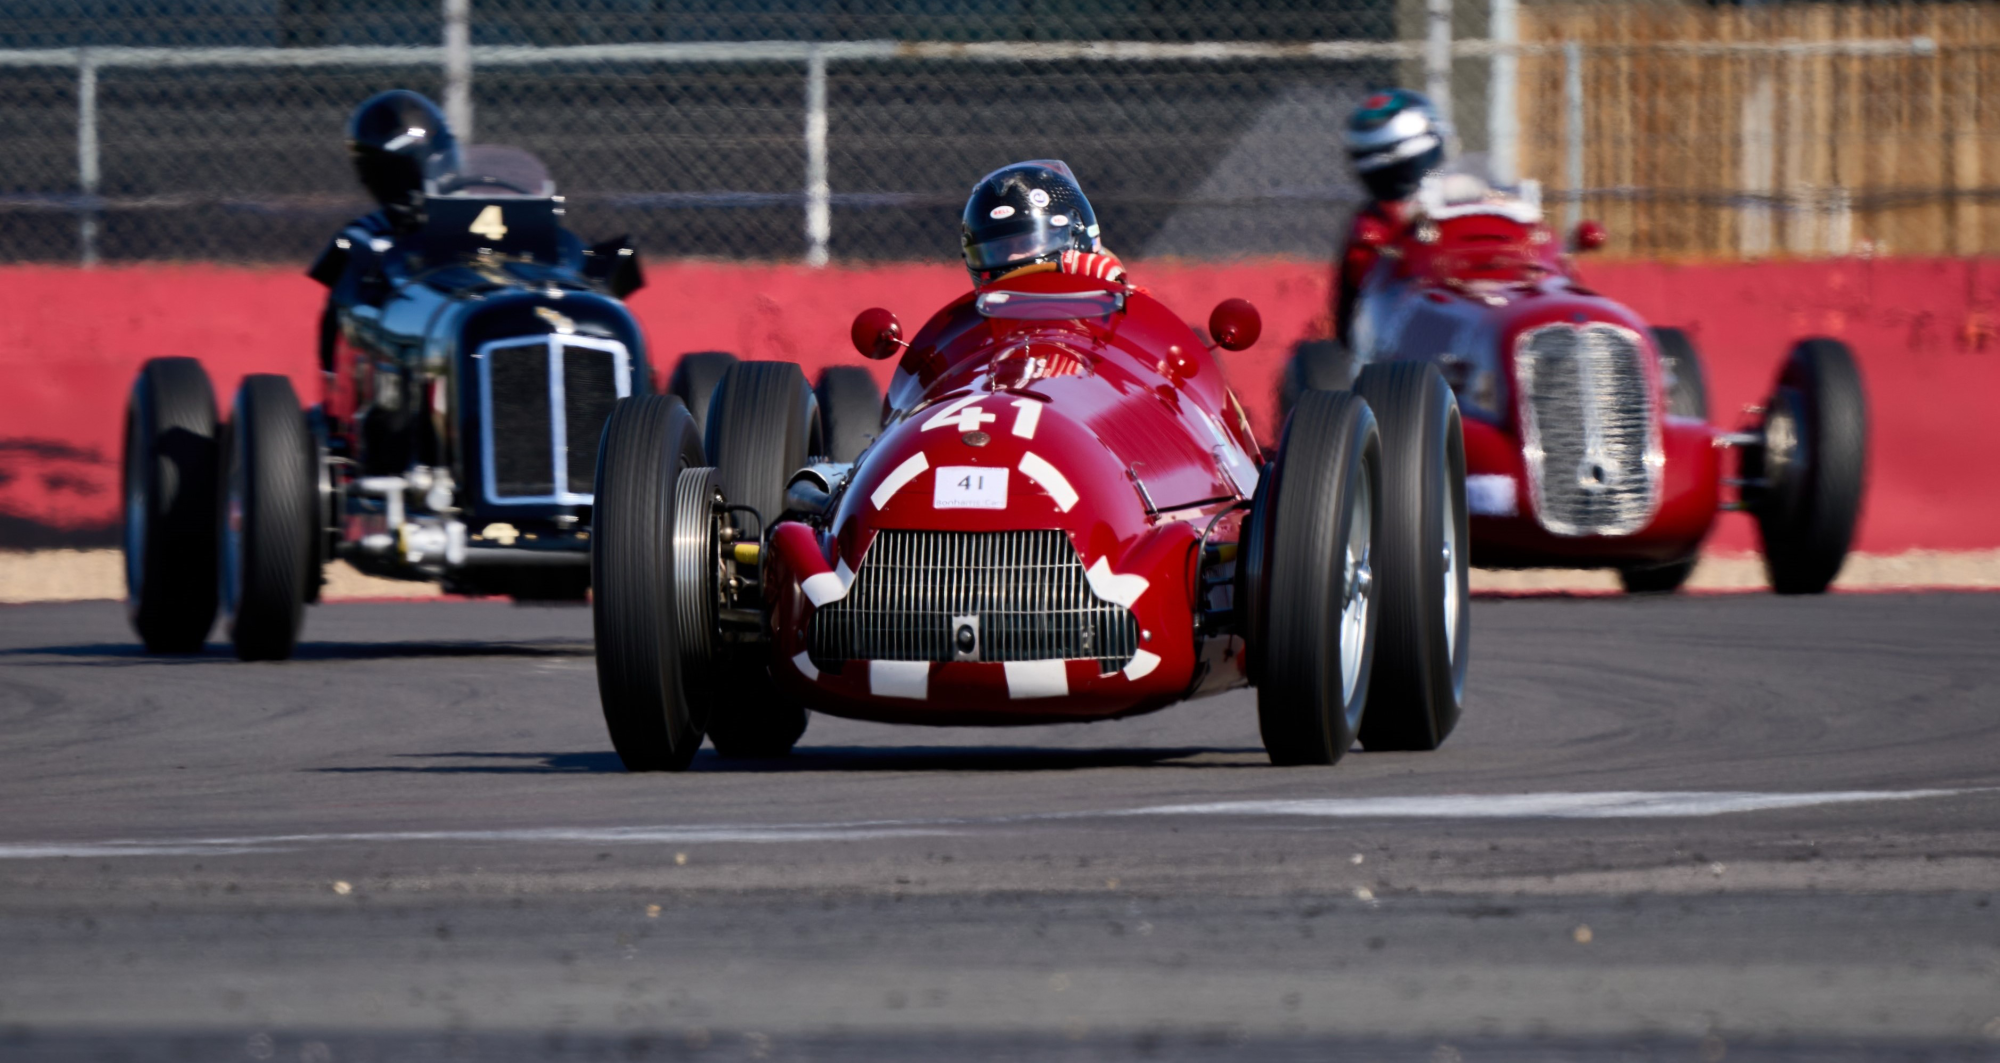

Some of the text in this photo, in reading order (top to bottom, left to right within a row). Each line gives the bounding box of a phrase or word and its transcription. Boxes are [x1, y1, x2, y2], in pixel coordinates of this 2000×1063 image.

[468, 205, 508, 241] 4
[921, 395, 1042, 440] 41
[957, 475, 984, 490] 41
